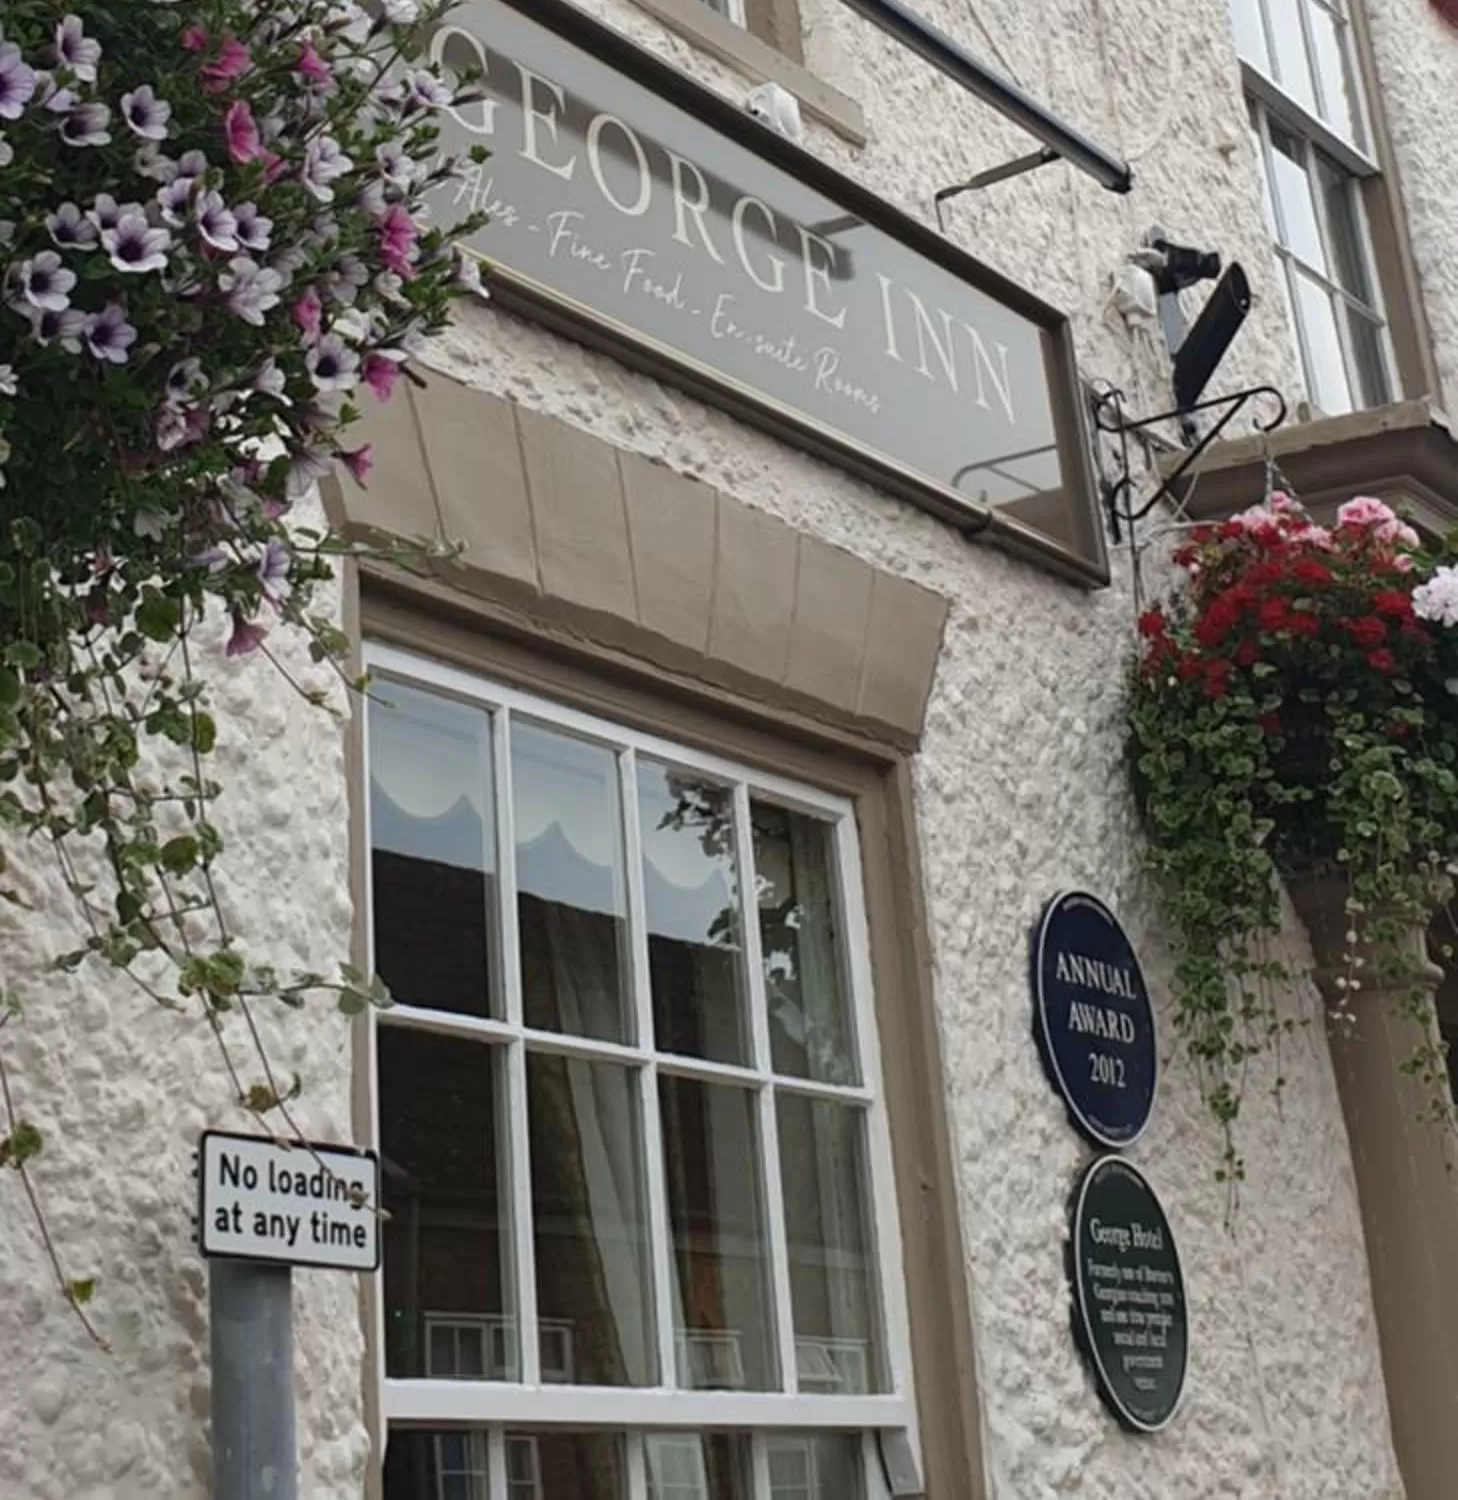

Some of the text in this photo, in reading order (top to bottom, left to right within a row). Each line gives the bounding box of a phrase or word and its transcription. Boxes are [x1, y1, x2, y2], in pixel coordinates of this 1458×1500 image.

[428, 25, 1015, 425] GEORGE INN
[547, 211, 612, 270] Fine
[621, 249, 685, 309] Food
[815, 346, 882, 415] Rooms
[1056, 952, 1137, 999] ANNUAL
[1068, 1000, 1135, 1044] AWARD
[1088, 1053, 1127, 1088] 2012
[219, 1152, 365, 1210] No loading
[215, 1201, 367, 1248] at any time
[1089, 1218, 1164, 1253] George Hotel
